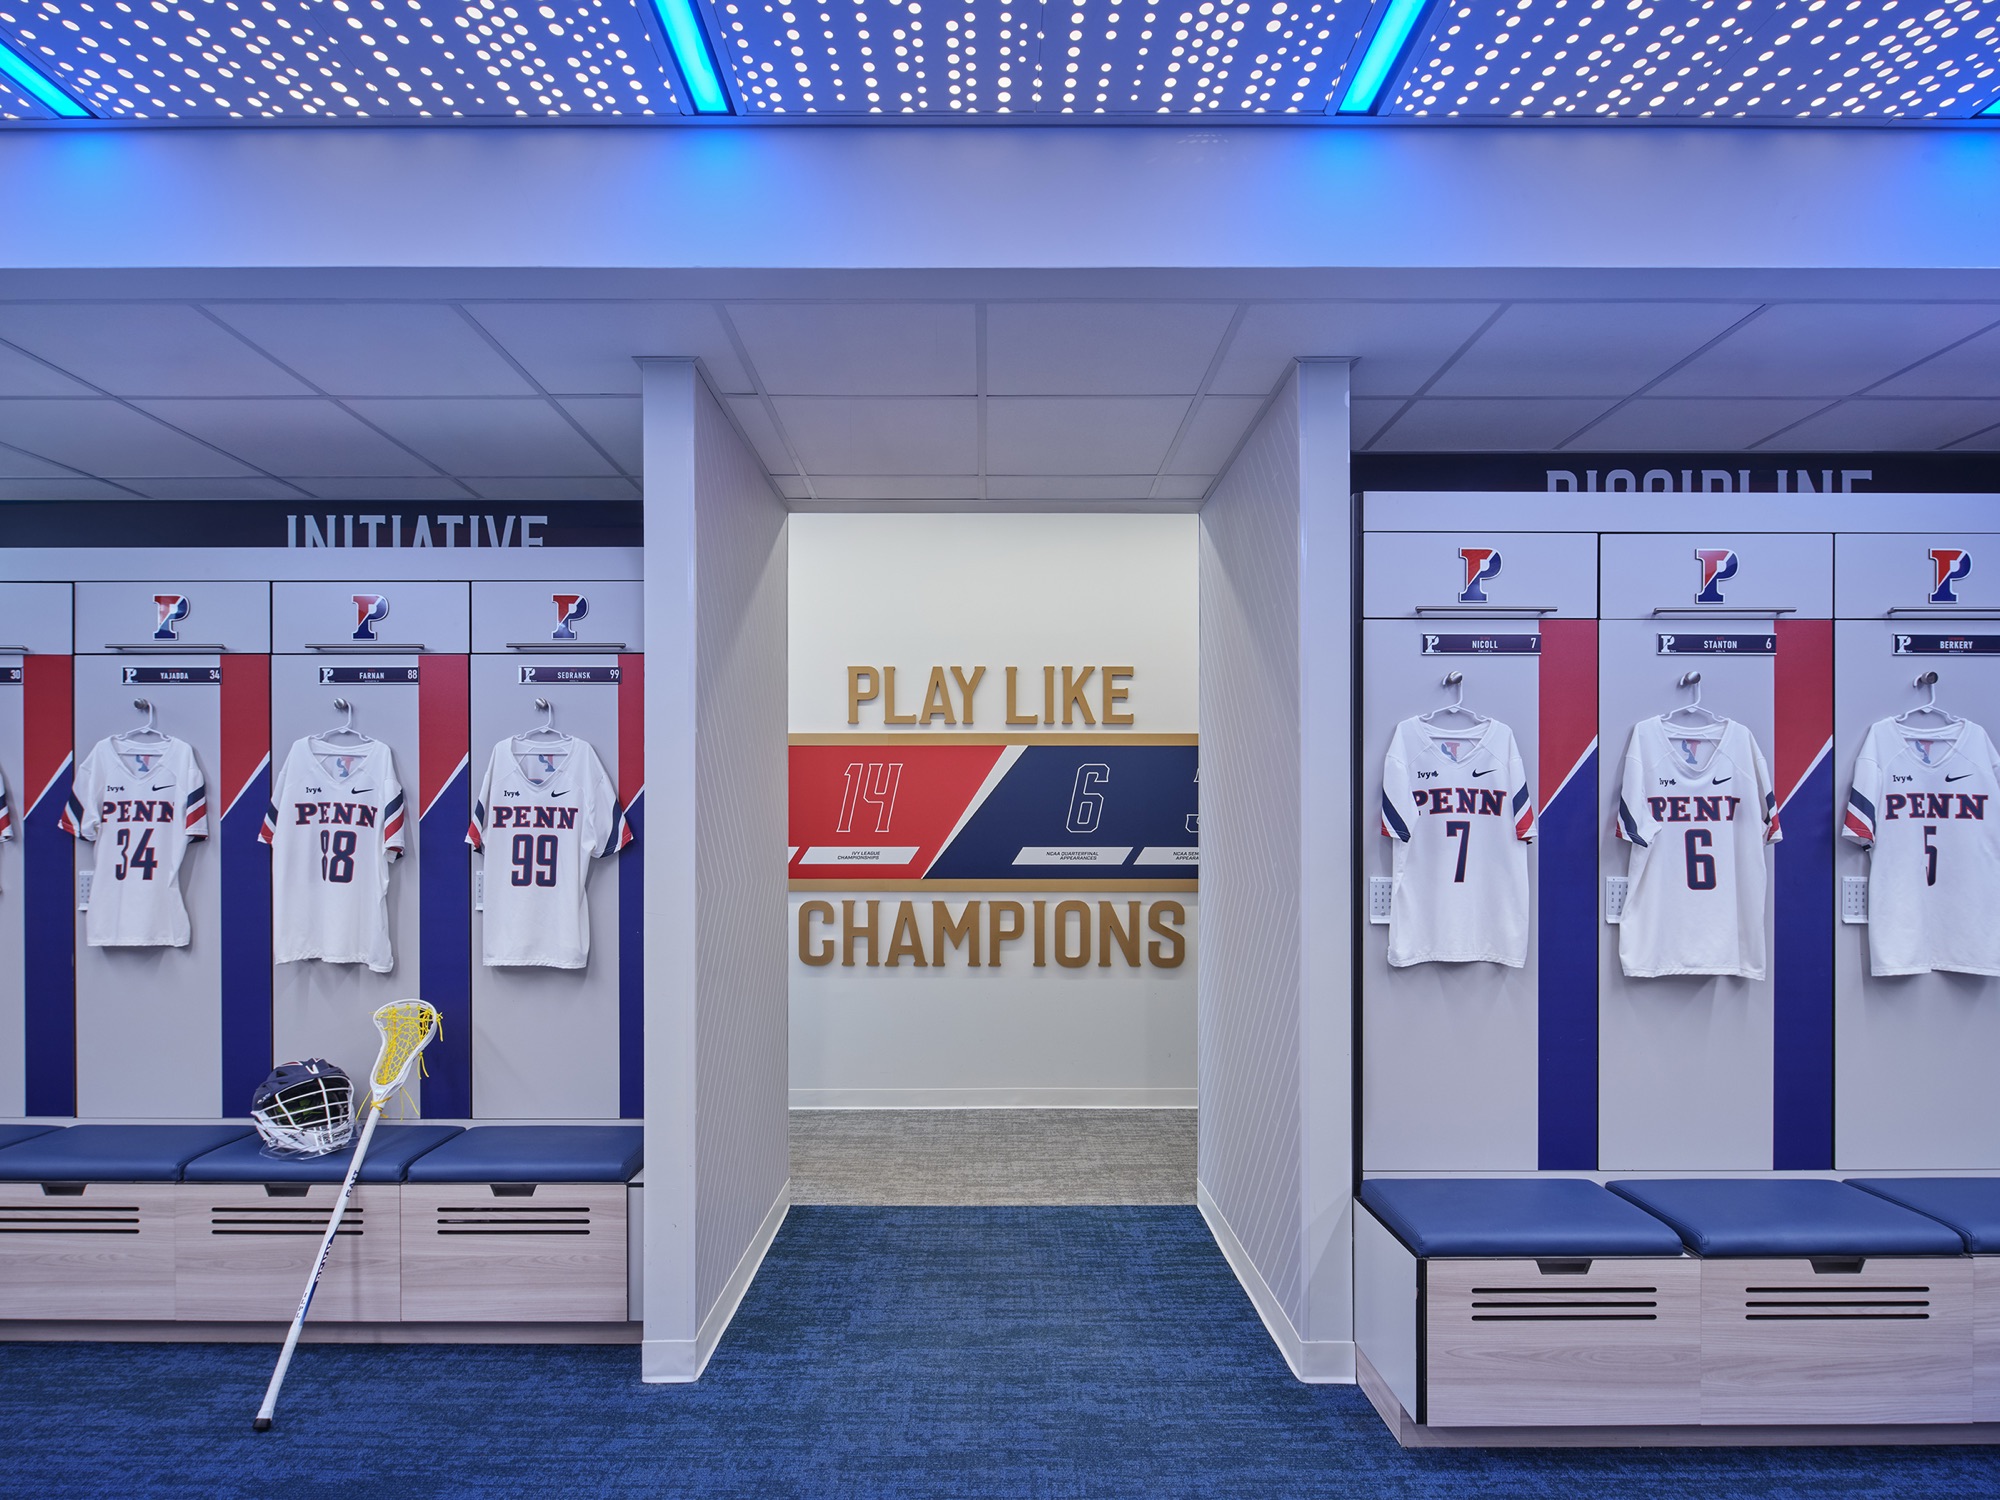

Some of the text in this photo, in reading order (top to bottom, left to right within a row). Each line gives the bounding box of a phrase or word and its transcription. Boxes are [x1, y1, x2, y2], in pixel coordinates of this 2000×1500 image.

[1458, 547, 1503, 603] P
[1695, 548, 1740, 604] P
[1928, 548, 1973, 604] P
[152, 594, 190, 641] P
[351, 594, 390, 641] P
[551, 593, 590, 640] P
[1471, 640, 1498, 648] NICOLL
[1530, 637, 1537, 648] 7
[1703, 640, 1737, 648] STANTON
[1765, 638, 1772, 649] 6
[1940, 641, 1973, 649] BERKERY
[10, 670, 21, 679] 30
[209, 669, 220, 680] 34
[407, 669, 418, 679] 88
[610, 669, 620, 679] 99
[847, 666, 1134, 725] PLAY LIKE
[504, 790, 515, 798] Ivy
[836, 763, 903, 833] 14
[1066, 763, 1110, 833] 6
[1417, 771, 1431, 780] Ivy
[1892, 775, 1906, 783] Ivy
[101, 800, 175, 823] PENN
[294, 802, 378, 828] PENN
[492, 806, 579, 829] PENN
[1885, 793, 1989, 820] PENN
[115, 828, 158, 881] 34
[511, 834, 558, 887] 99
[1446, 821, 1471, 883] 7
[1685, 829, 1717, 890] 6
[1923, 825, 1938, 887] 5
[799, 900, 1185, 968] CHAMPIONS
